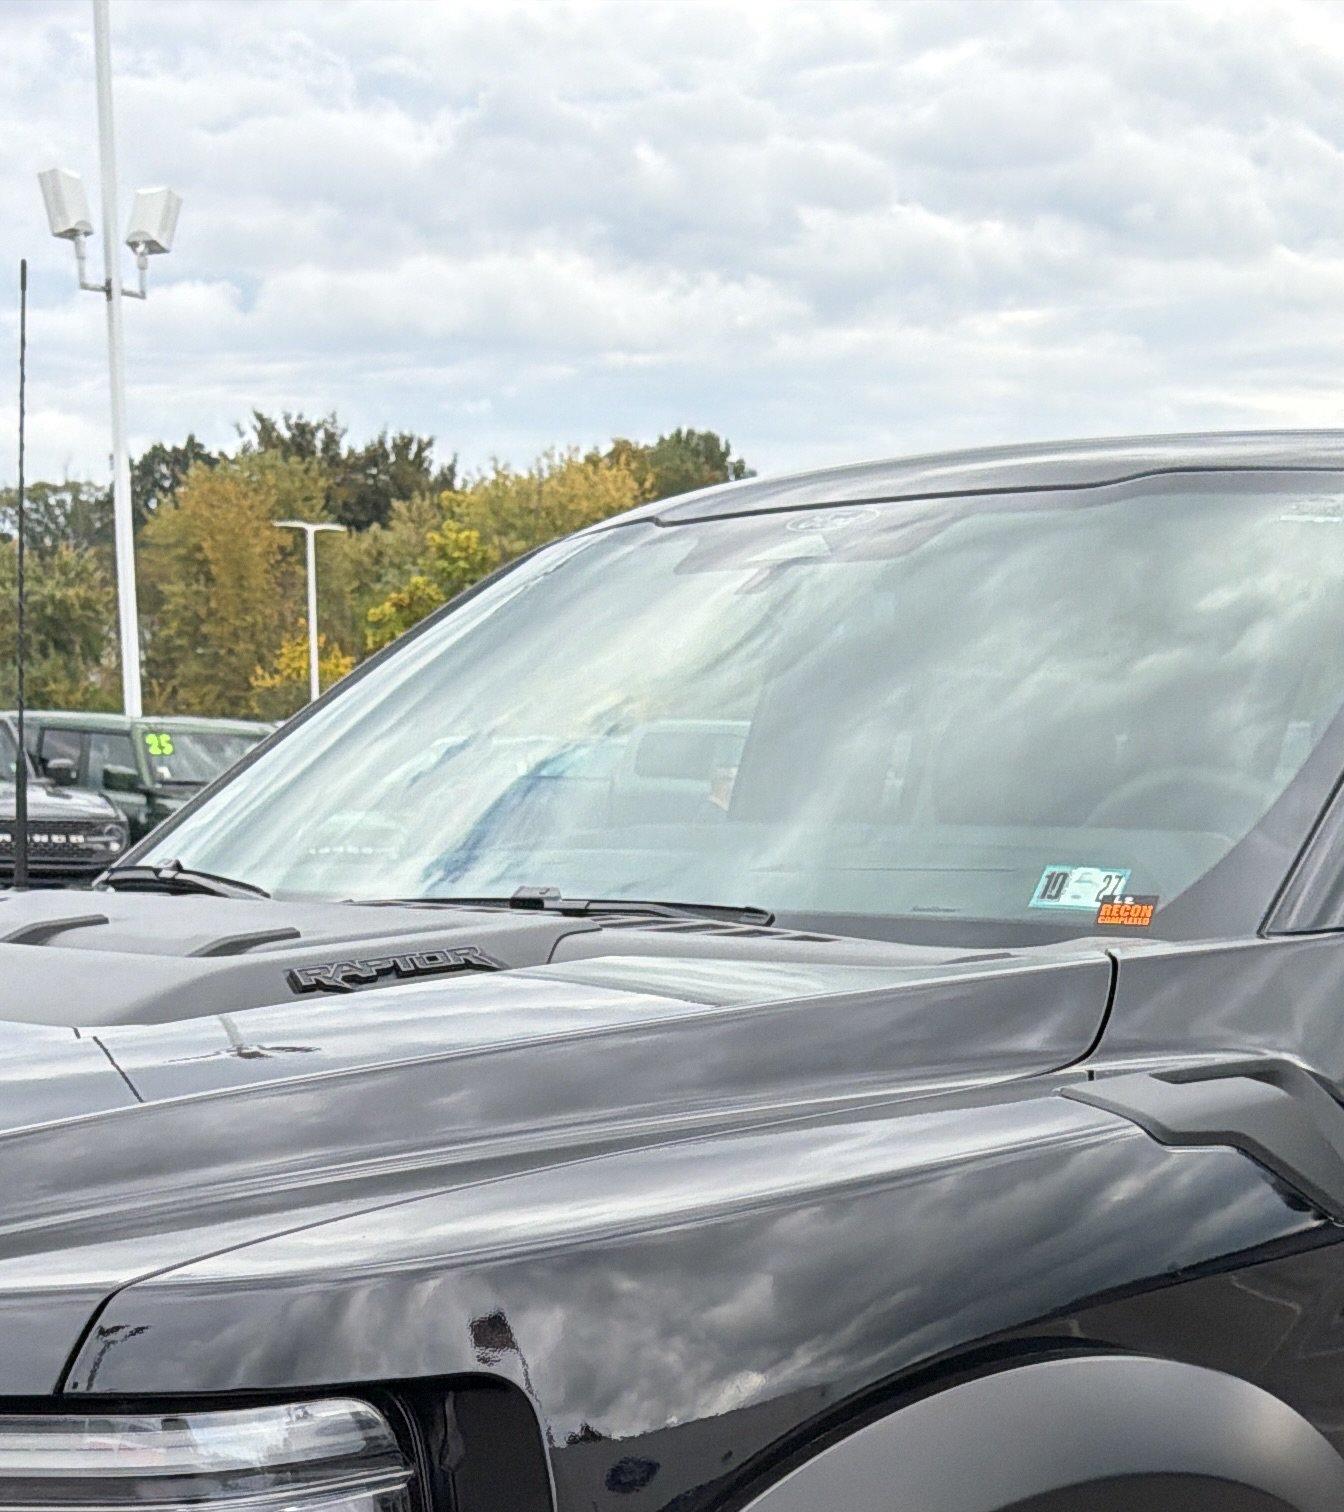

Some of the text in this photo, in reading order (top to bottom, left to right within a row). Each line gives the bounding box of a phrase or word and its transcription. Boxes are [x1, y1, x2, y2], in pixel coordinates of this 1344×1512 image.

[145, 733, 174, 755] 25
[1095, 874, 1124, 902] 27
[1099, 904, 1154, 917] RECON
[290, 945, 503, 992] RAPTOR
